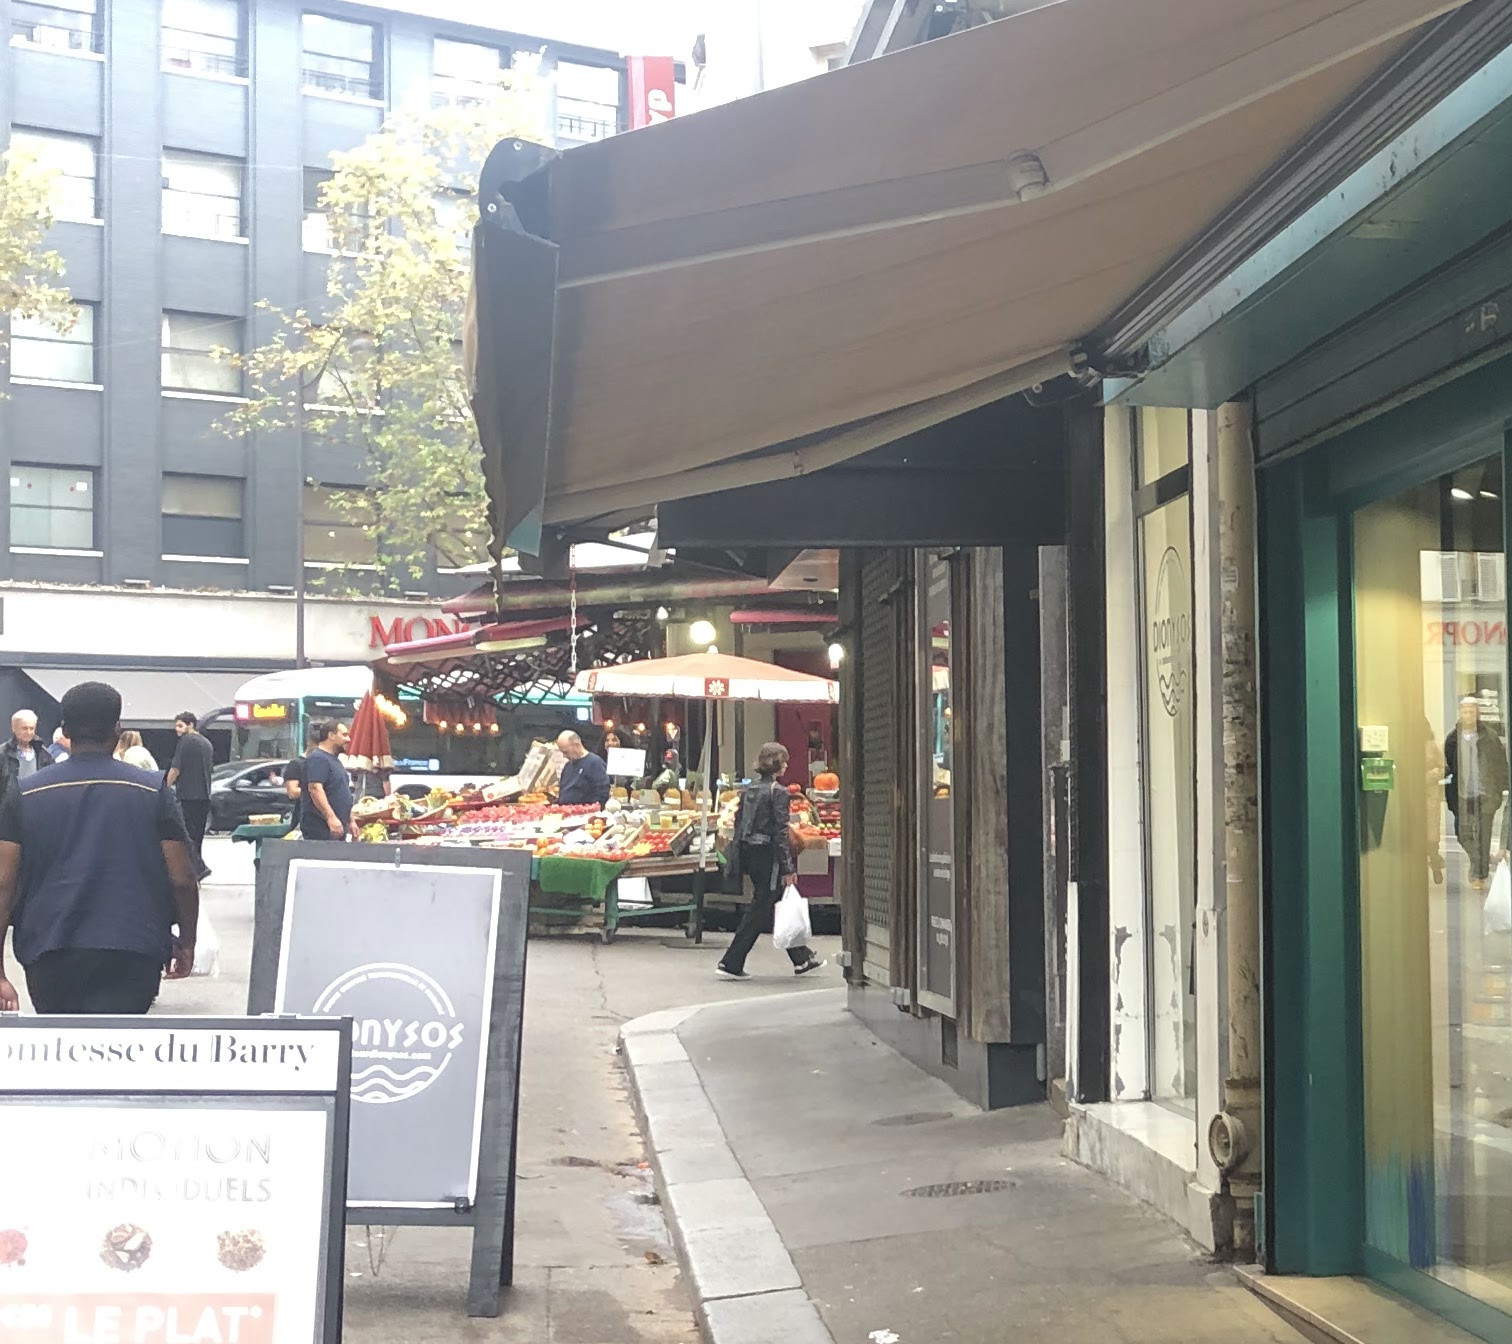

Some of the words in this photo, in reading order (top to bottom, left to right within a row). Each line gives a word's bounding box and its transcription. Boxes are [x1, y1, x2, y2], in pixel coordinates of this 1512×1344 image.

[368, 613, 471, 648] MON
[154, 1033, 198, 1063] du
[210, 1034, 316, 1071] Barry
[352, 1018, 465, 1050] NYSOS
[64, 1305, 123, 1344] LE
